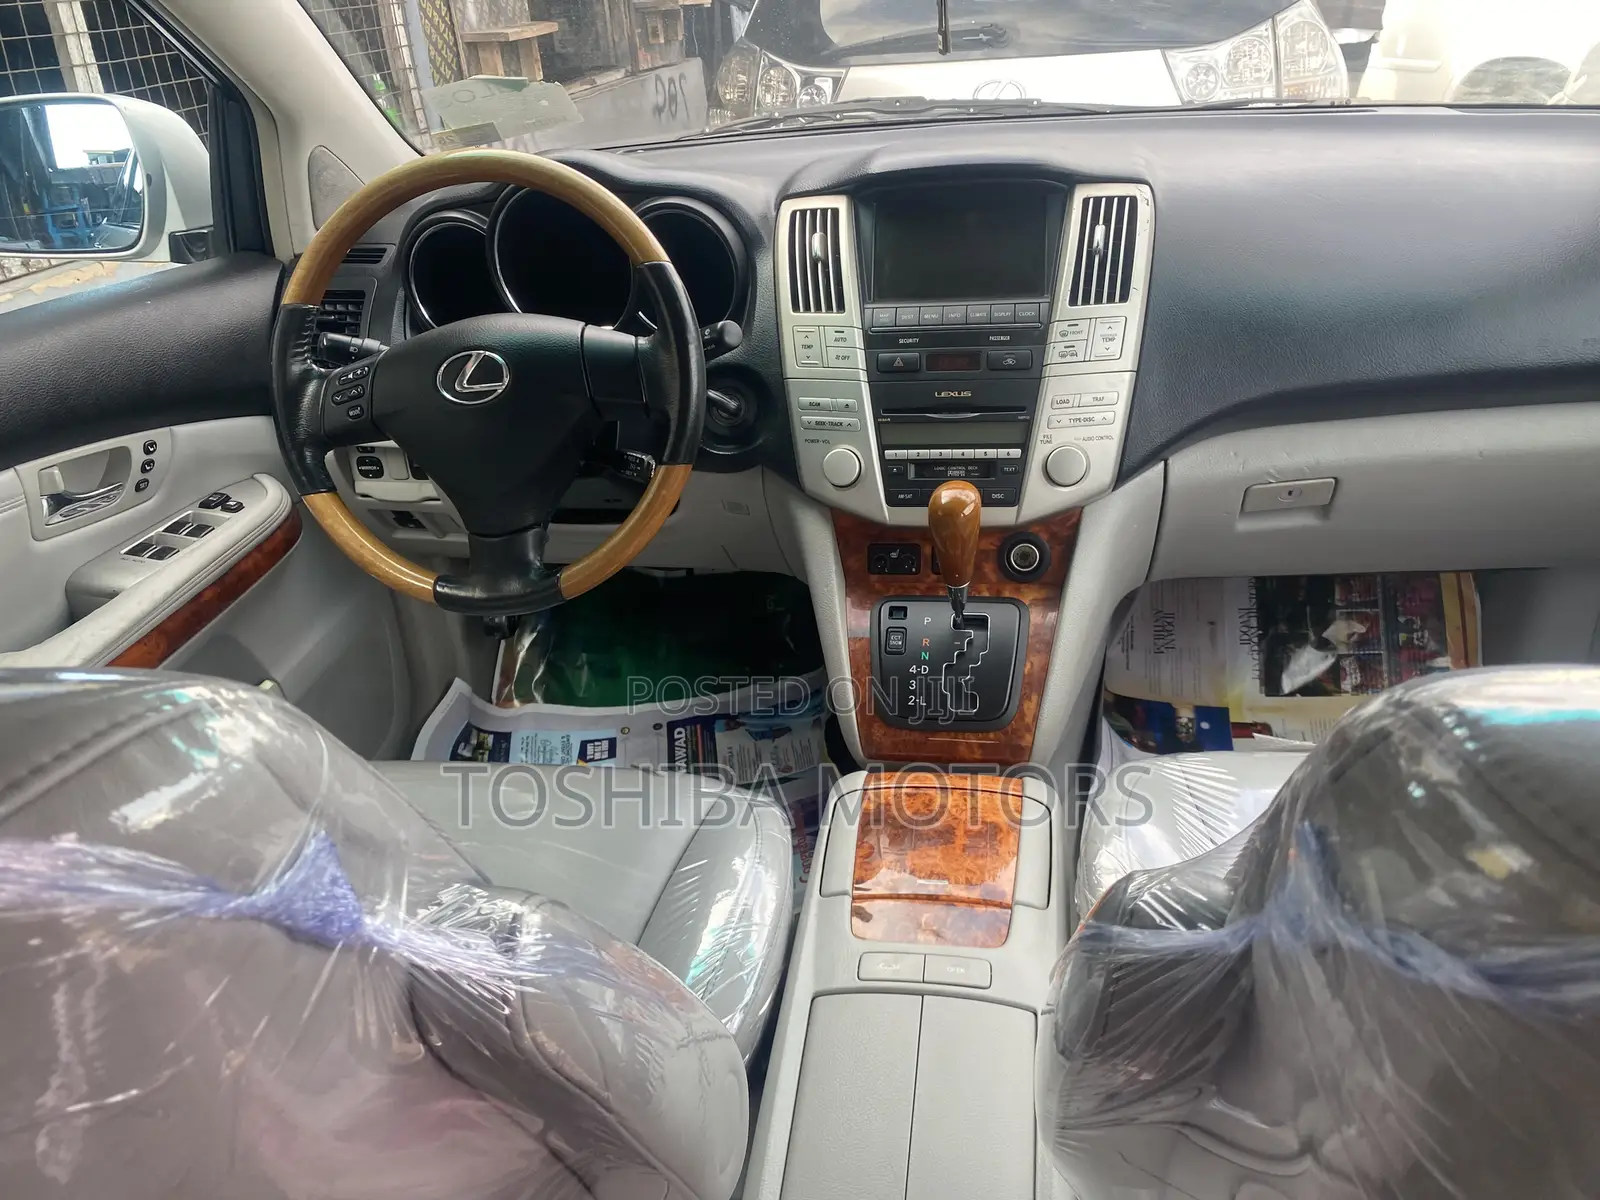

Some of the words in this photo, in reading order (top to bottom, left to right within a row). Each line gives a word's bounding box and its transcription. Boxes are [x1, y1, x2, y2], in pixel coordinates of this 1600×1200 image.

[934, 390, 972, 398] LEXUS
[924, 617, 932, 625] P
[922, 638, 930, 646] R
[921, 652, 929, 660] N
[909, 665, 929, 674] 4-D
[909, 680, 917, 689] 3
[908, 695, 927, 706] 2-L
